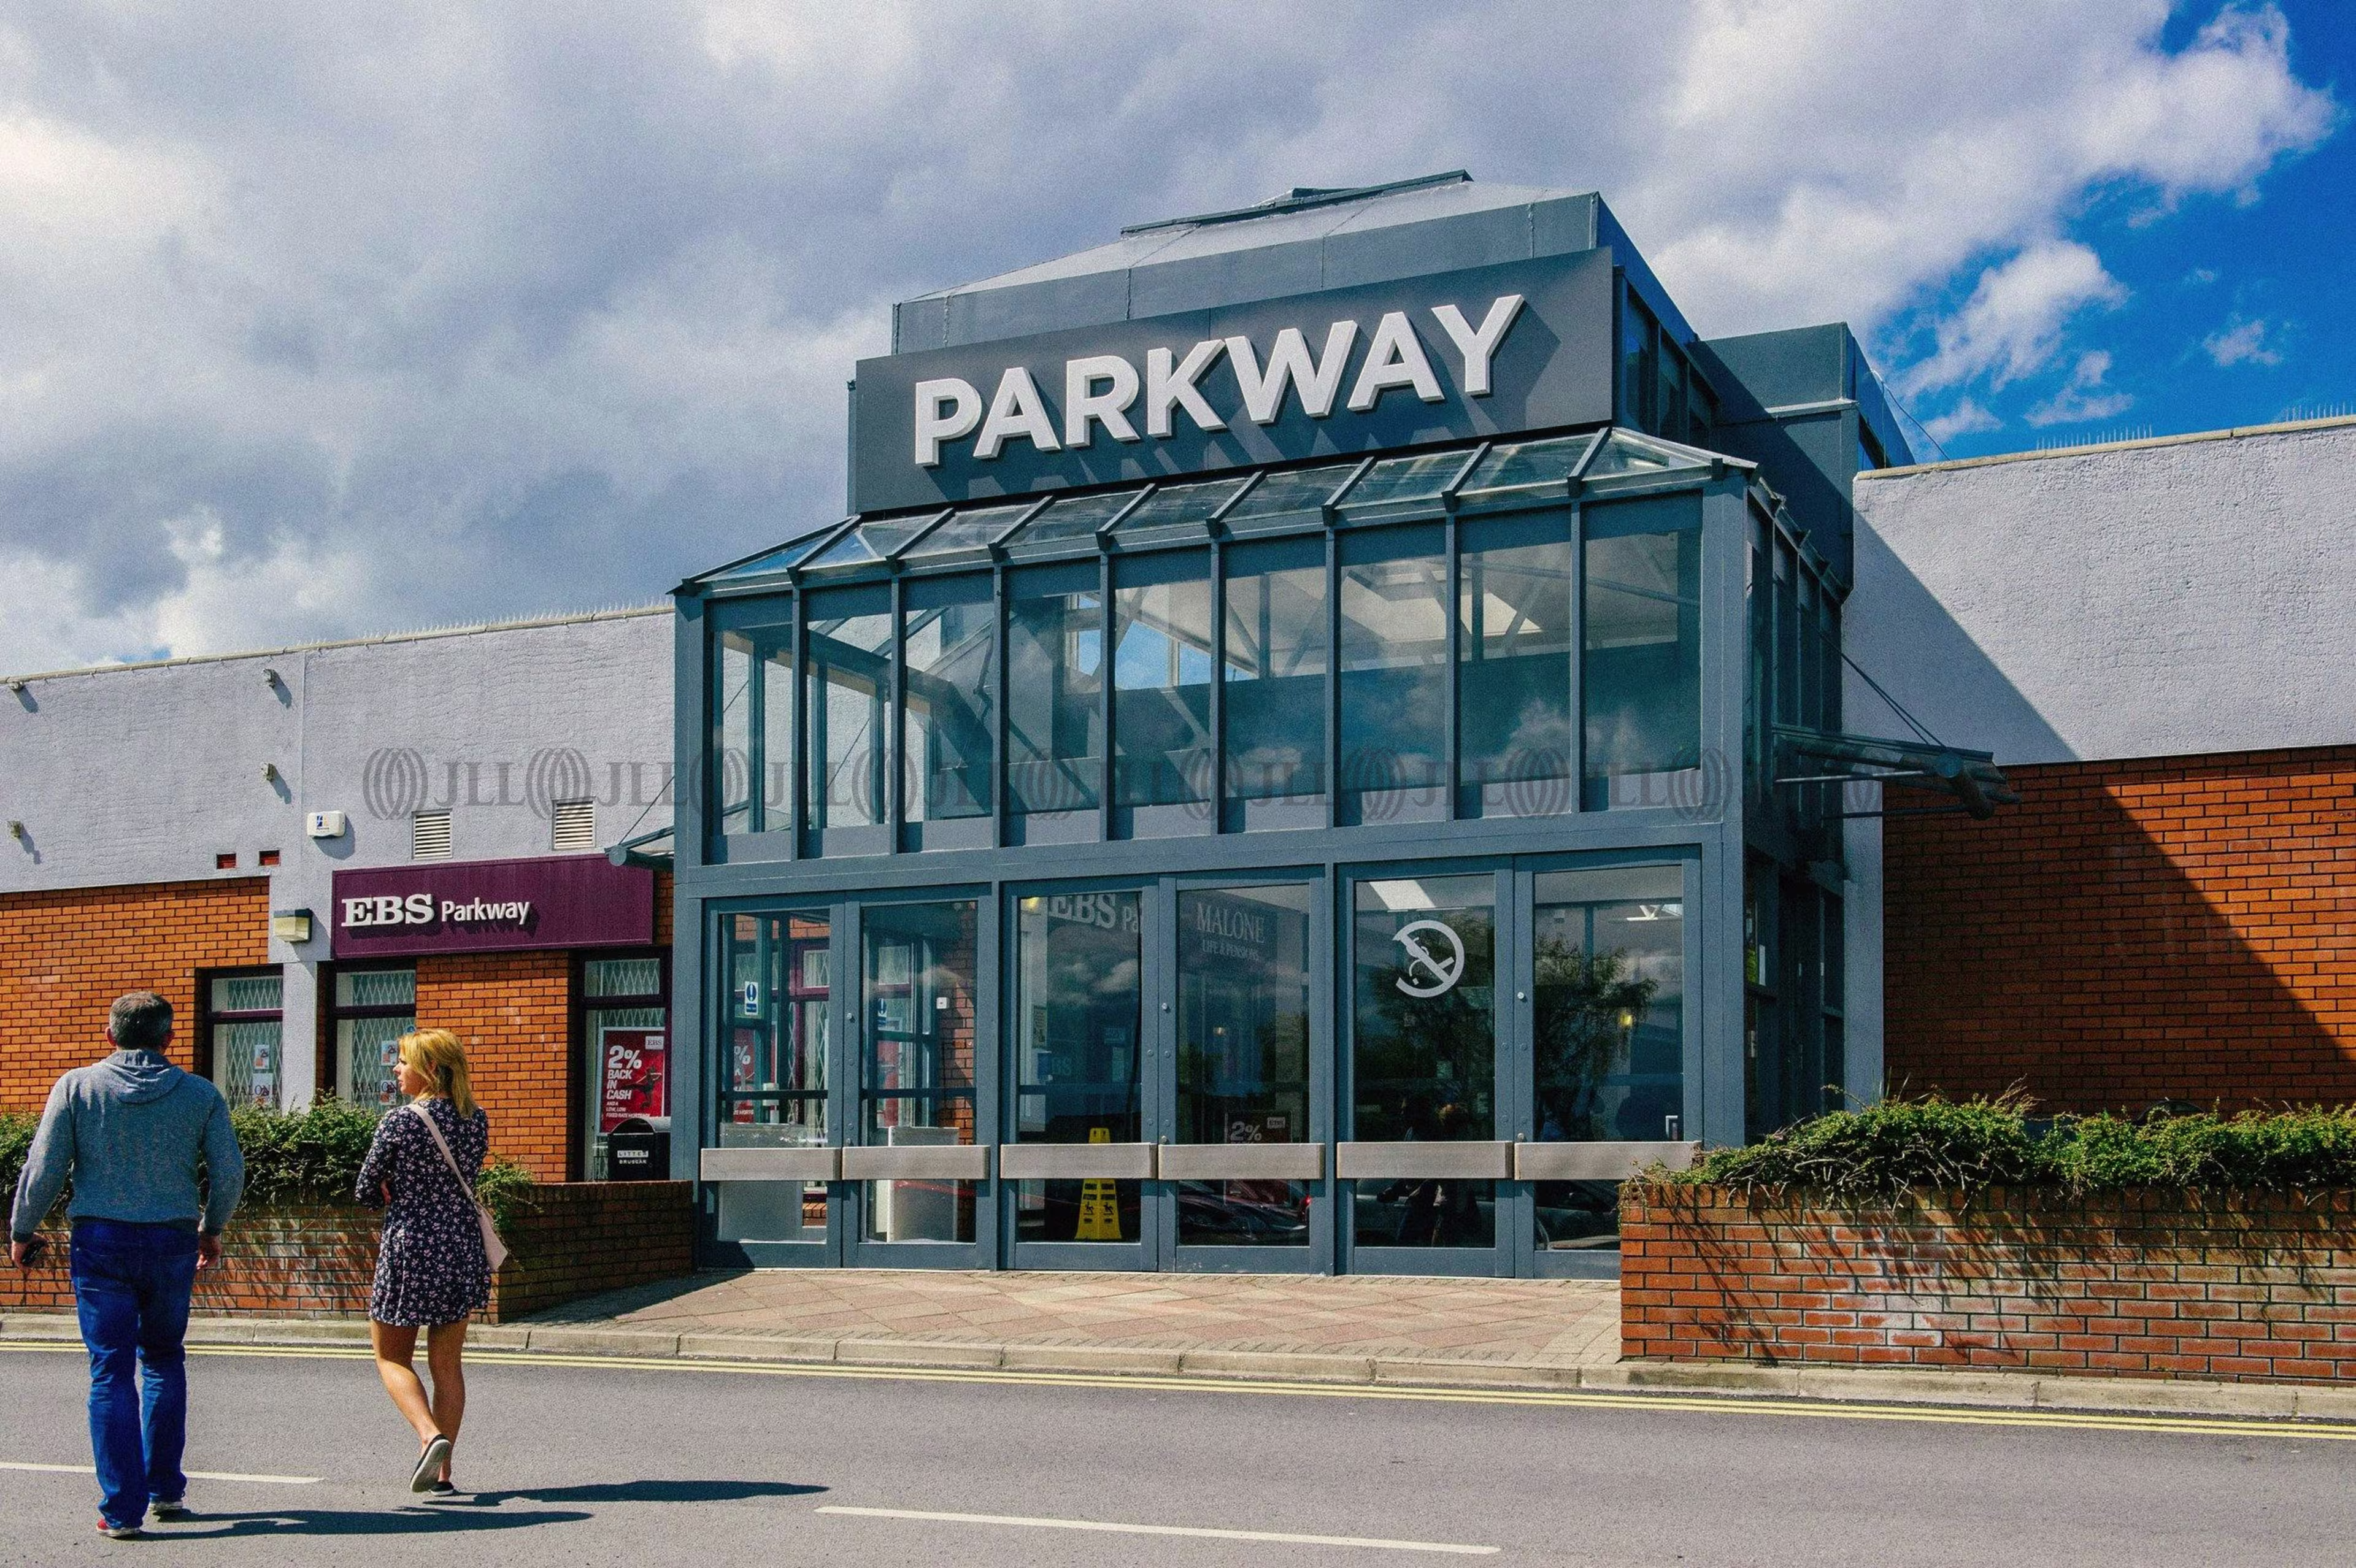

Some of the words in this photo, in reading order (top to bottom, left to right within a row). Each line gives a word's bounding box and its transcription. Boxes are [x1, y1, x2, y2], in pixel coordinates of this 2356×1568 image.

[915, 293, 1525, 466] PARKWAY
[341, 893, 435, 927] EBS
[441, 897, 530, 925] Parkway
[1197, 902, 1265, 943] MALONE
[608, 1045, 642, 1069] 2%
[607, 1069, 633, 1079] BACK
[354, 1081, 398, 1093] MALON
[606, 1090, 632, 1100] CASH
[607, 1080, 618, 1090] IN
[1230, 1121, 1262, 1141] 2%
